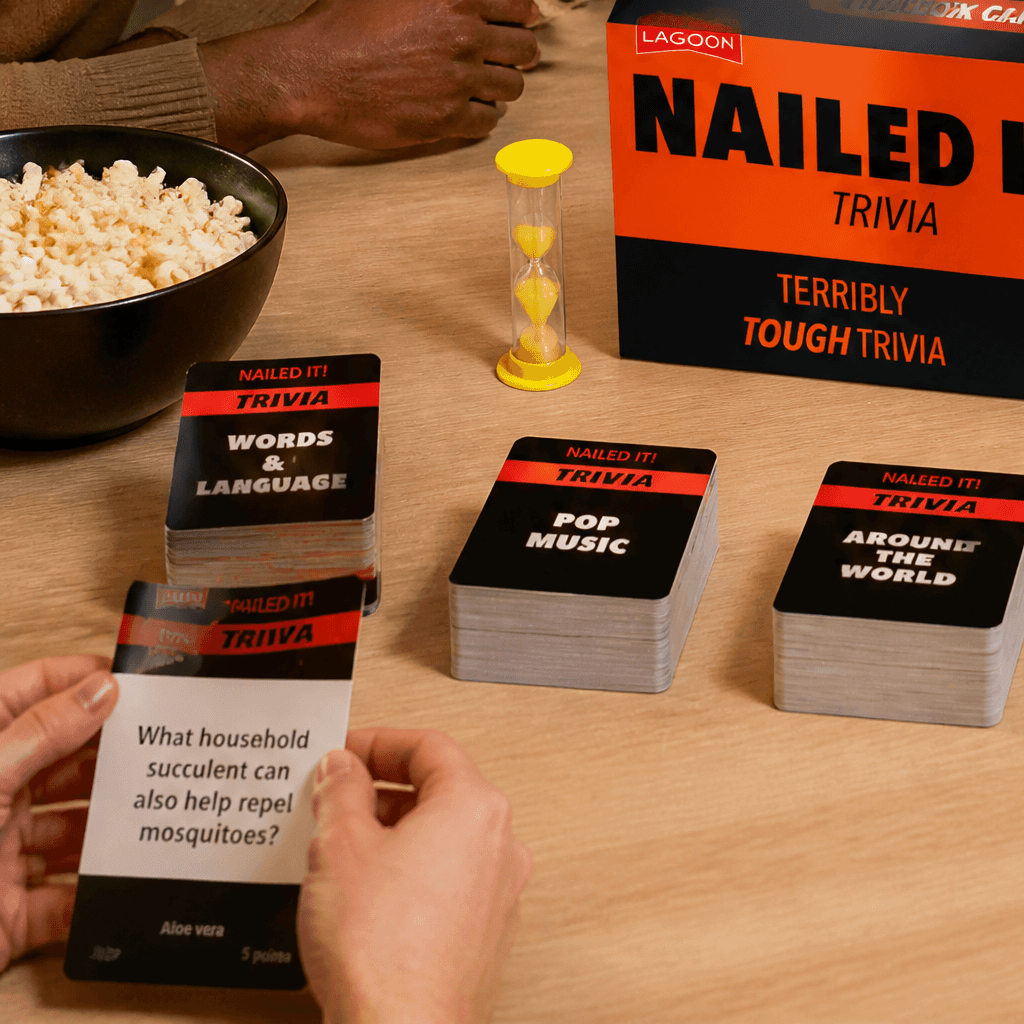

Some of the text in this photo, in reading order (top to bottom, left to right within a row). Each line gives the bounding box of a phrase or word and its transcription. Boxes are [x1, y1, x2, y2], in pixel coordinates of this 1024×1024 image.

[643, 30, 734, 49] LAGOON
[633, 73, 975, 187] NAILED
[833, 191, 938, 236] TRIVIA
[777, 273, 909, 316] TERRIBLY
[743, 316, 947, 367] TOUGH TRIVIA
[239, 365, 328, 381] NAILED IT!
[236, 390, 329, 409] TRIVIA
[227, 430, 334, 451] WORDS
[262, 455, 285, 472] &
[566, 446, 657, 463] NAILED IT!
[195, 473, 347, 496] LANGUAGE
[556, 468, 653, 487] TRIVIA
[958, 477, 981, 489] IT!
[872, 493, 977, 514] TRIVIA
[553, 512, 620, 531] POP
[525, 532, 630, 555] MUSIC
[876, 549, 935, 567] THE
[841, 564, 957, 586] WORLD
[293, 591, 315, 608] IT!
[137, 725, 310, 749] What household
[146, 759, 290, 780] succulent can
[133, 789, 294, 818] also help repel
[139, 824, 280, 849] mosquitoes?
[159, 921, 225, 937] Aloe vera
